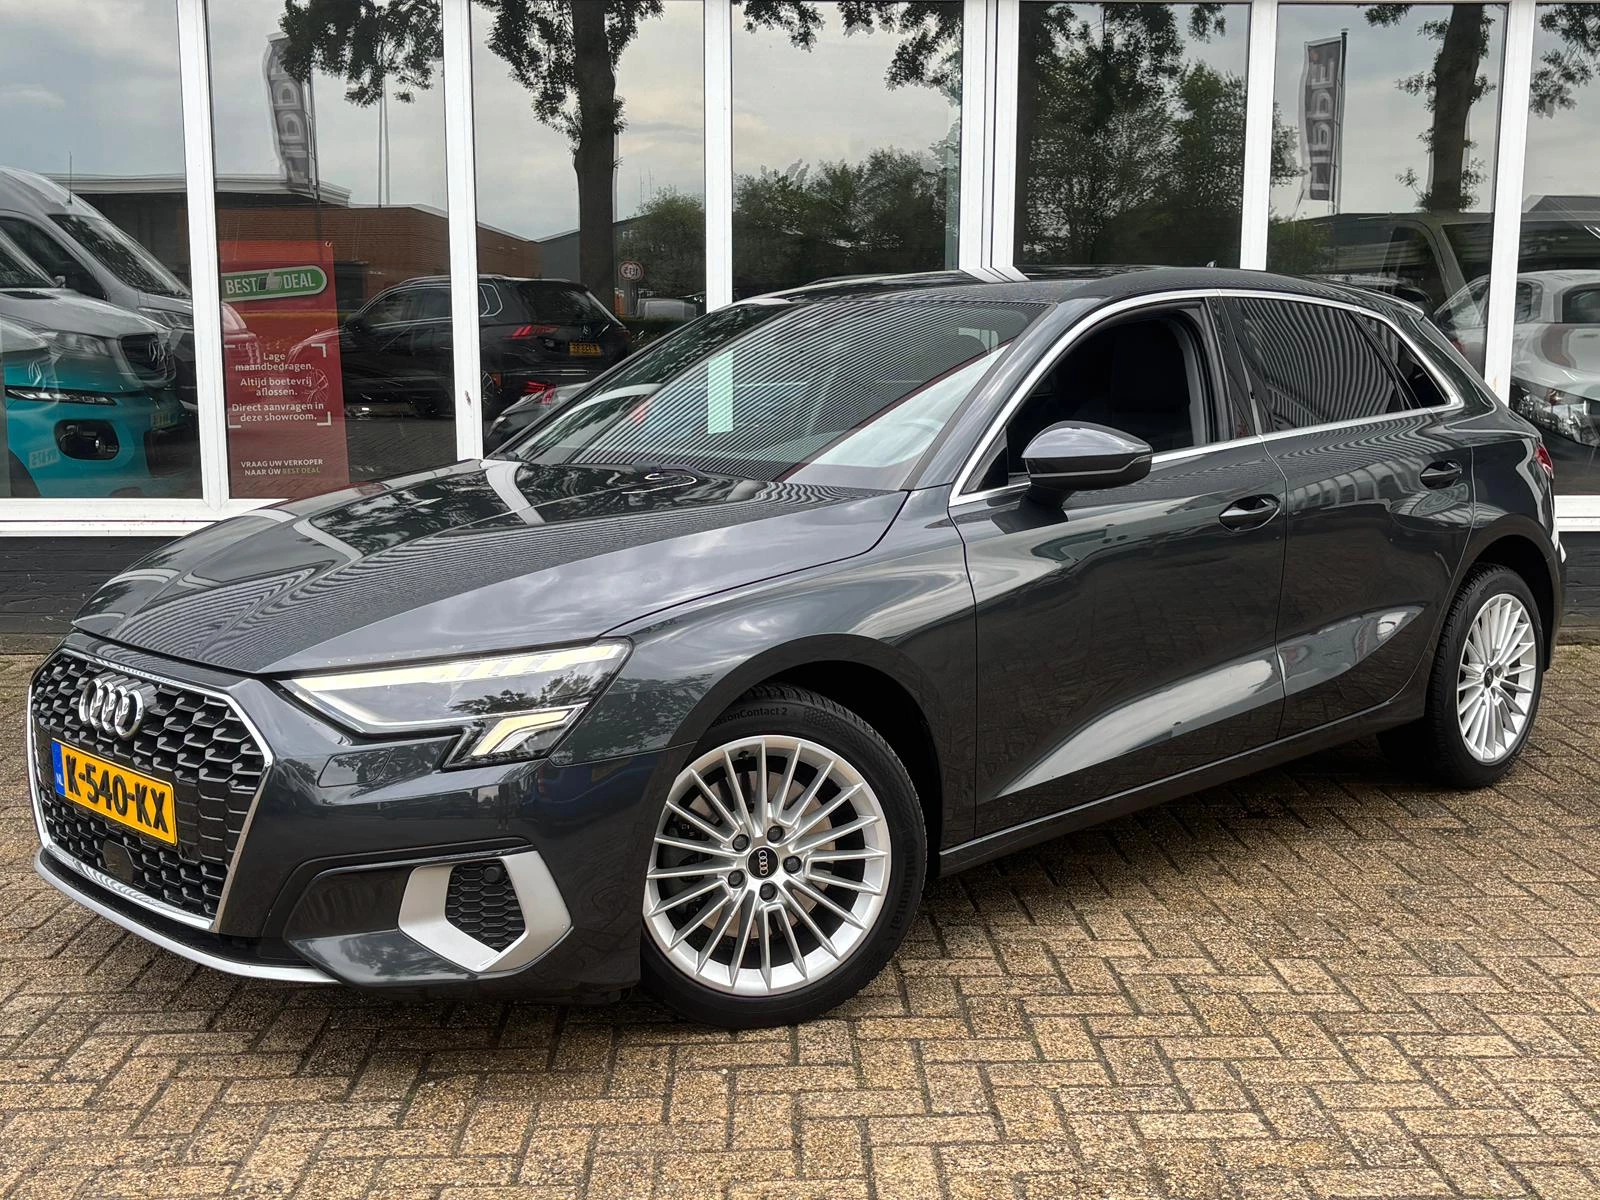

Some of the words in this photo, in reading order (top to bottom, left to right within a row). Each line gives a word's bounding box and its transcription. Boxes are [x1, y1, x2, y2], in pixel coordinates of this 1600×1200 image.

[225, 277, 257, 294] BEST
[283, 272, 316, 289] DEAL
[263, 352, 286, 362] Lage
[235, 362, 315, 372] maandbedragen.
[240, 378, 267, 388] Altijd
[269, 376, 312, 386] boetevrij
[256, 387, 298, 396] aflossen.
[231, 403, 261, 412] Direct
[264, 403, 313, 413] aanvragen
[315, 402, 324, 410] in
[240, 413, 263, 422] deze
[264, 412, 317, 421] showroom.
[240, 460, 268, 468] VRAAG
[269, 459, 282, 467] UW
[283, 458, 324, 466] VERKOPER
[282, 467, 300, 475] BEST
[301, 466, 320, 474] DEAL
[781, 706, 789, 717] 2
[65, 754, 169, 834] K-540-KX
